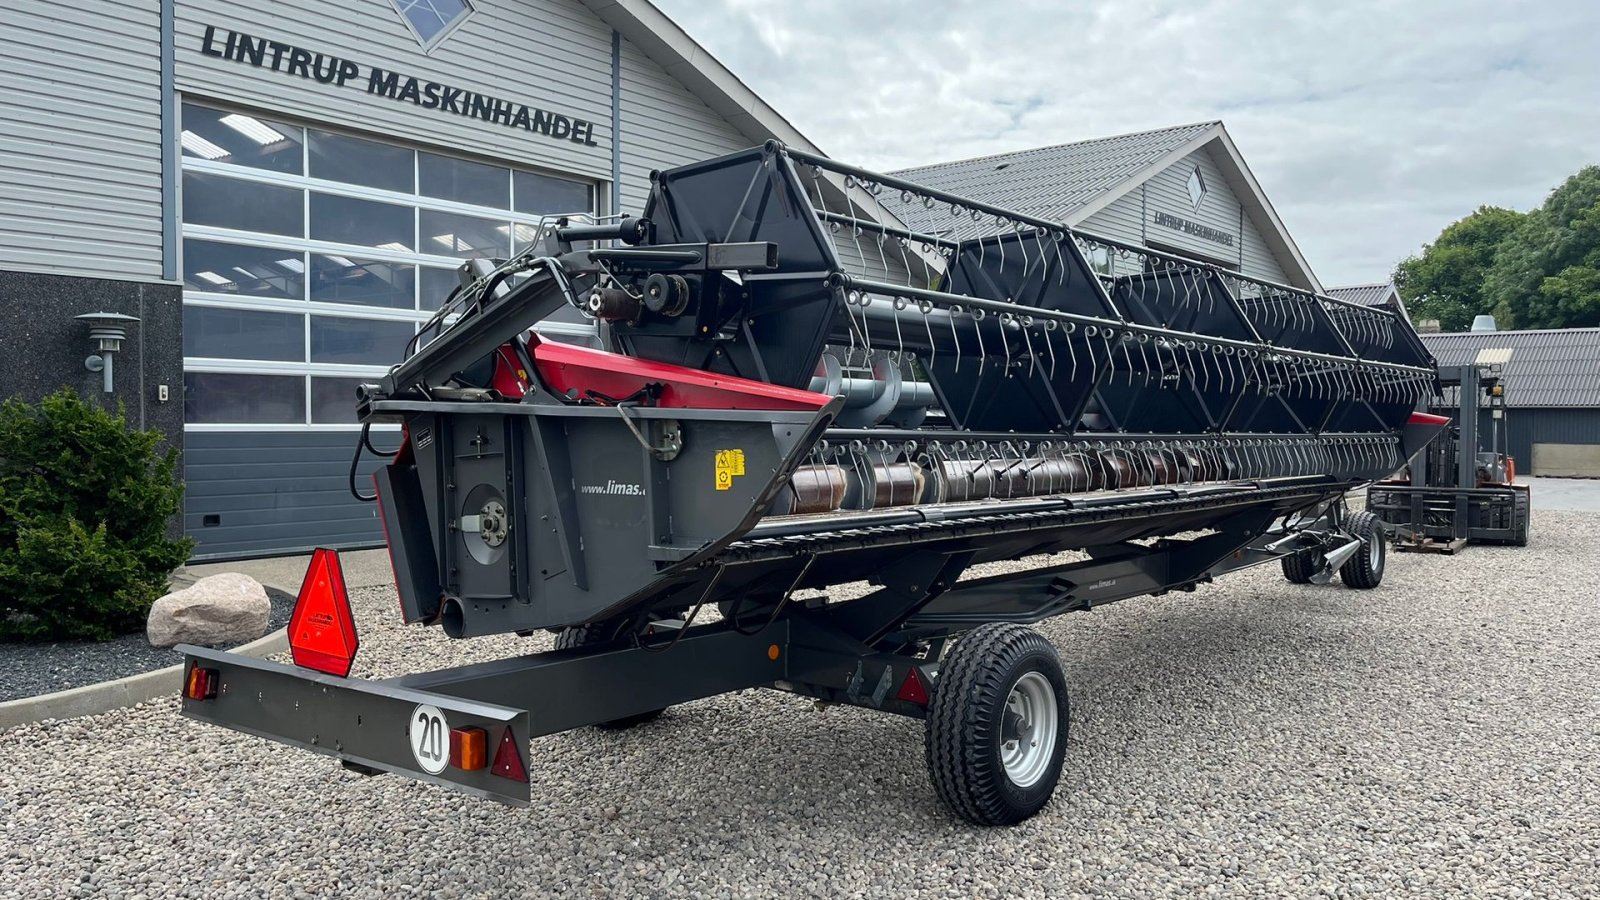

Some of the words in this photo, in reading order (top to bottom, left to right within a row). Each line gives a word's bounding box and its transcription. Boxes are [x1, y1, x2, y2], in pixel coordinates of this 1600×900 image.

[201, 25, 360, 87] LINTRUP
[367, 67, 598, 147] MASKINHANDEL
[1154, 210, 1183, 231] LINTRUP
[1184, 219, 1234, 247] MASKINHANDEL
[419, 712, 443, 762] 20
